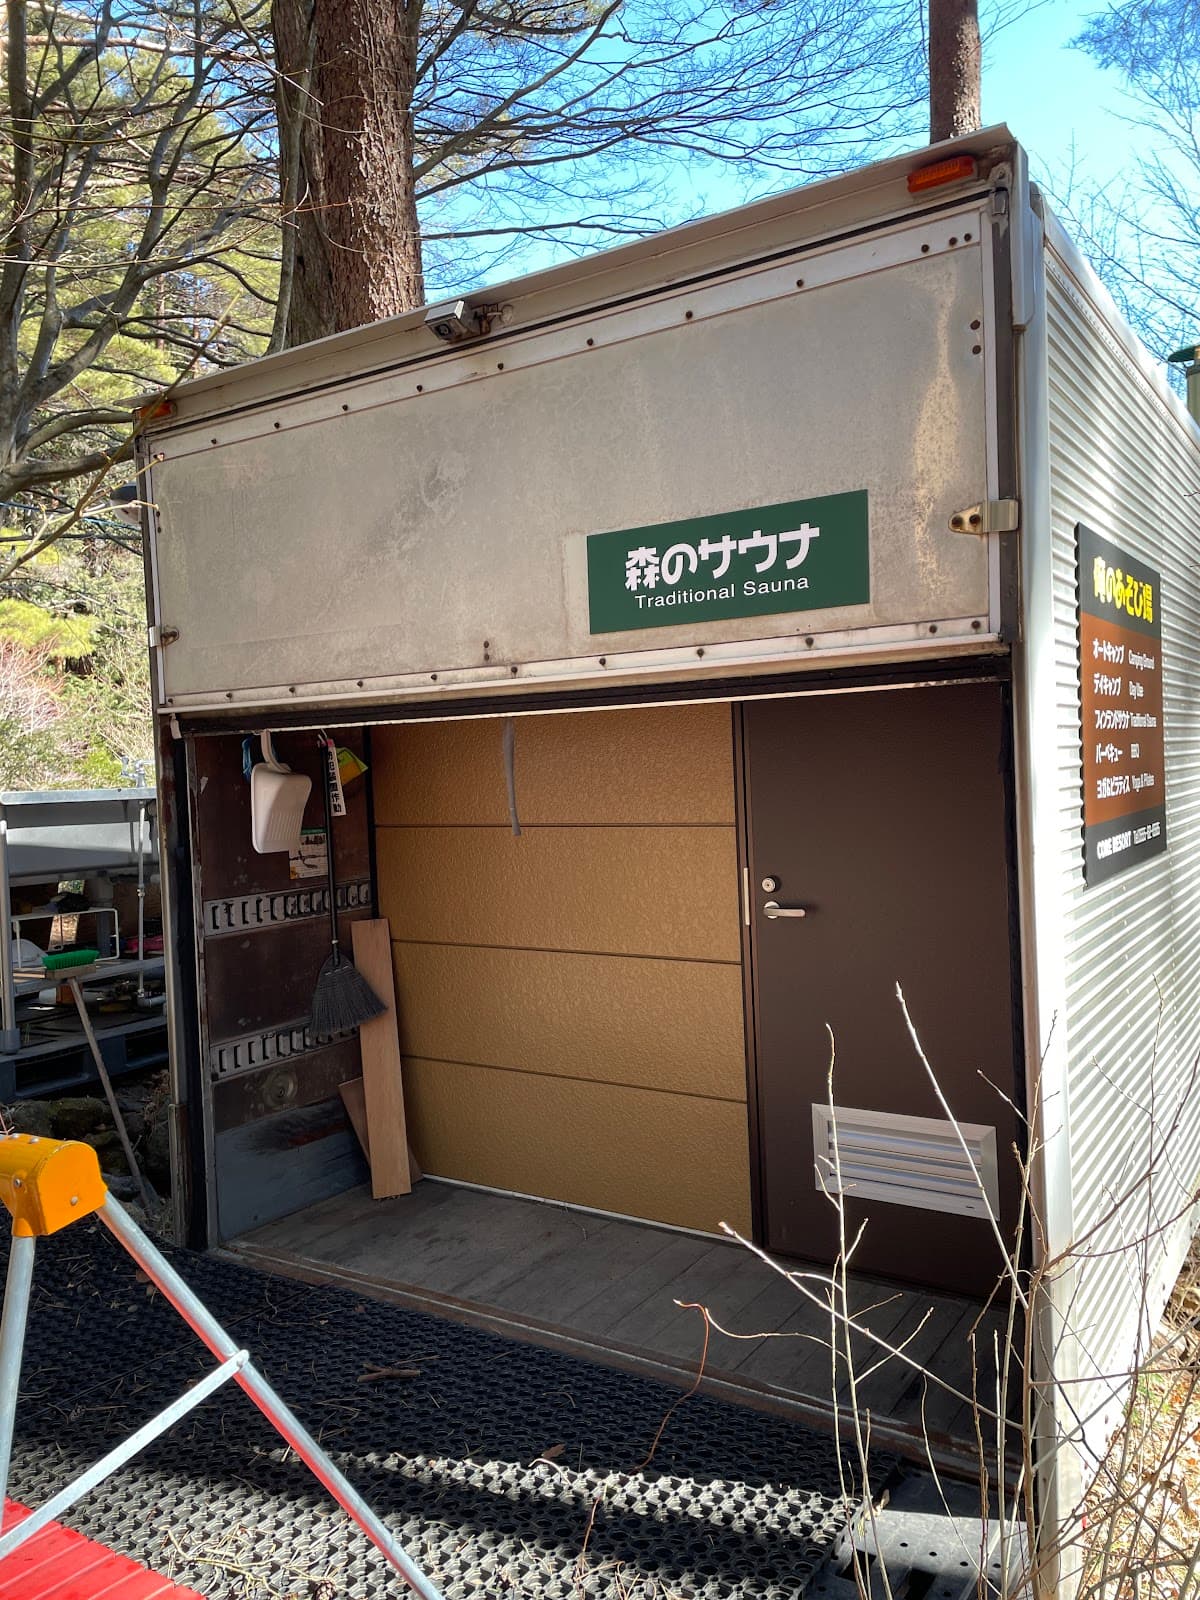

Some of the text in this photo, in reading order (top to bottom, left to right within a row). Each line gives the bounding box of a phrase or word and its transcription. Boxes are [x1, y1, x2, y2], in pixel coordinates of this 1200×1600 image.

[625, 522, 820, 592] 森のサウナ
[635, 577, 809, 609] Traditional Sauna
[1092, 637, 1125, 665] オートキャンプ
[1093, 672, 1122, 696] デイキャンプ
[1095, 743, 1124, 764] バーベキュー
[1112, 830, 1132, 854] RESORT
